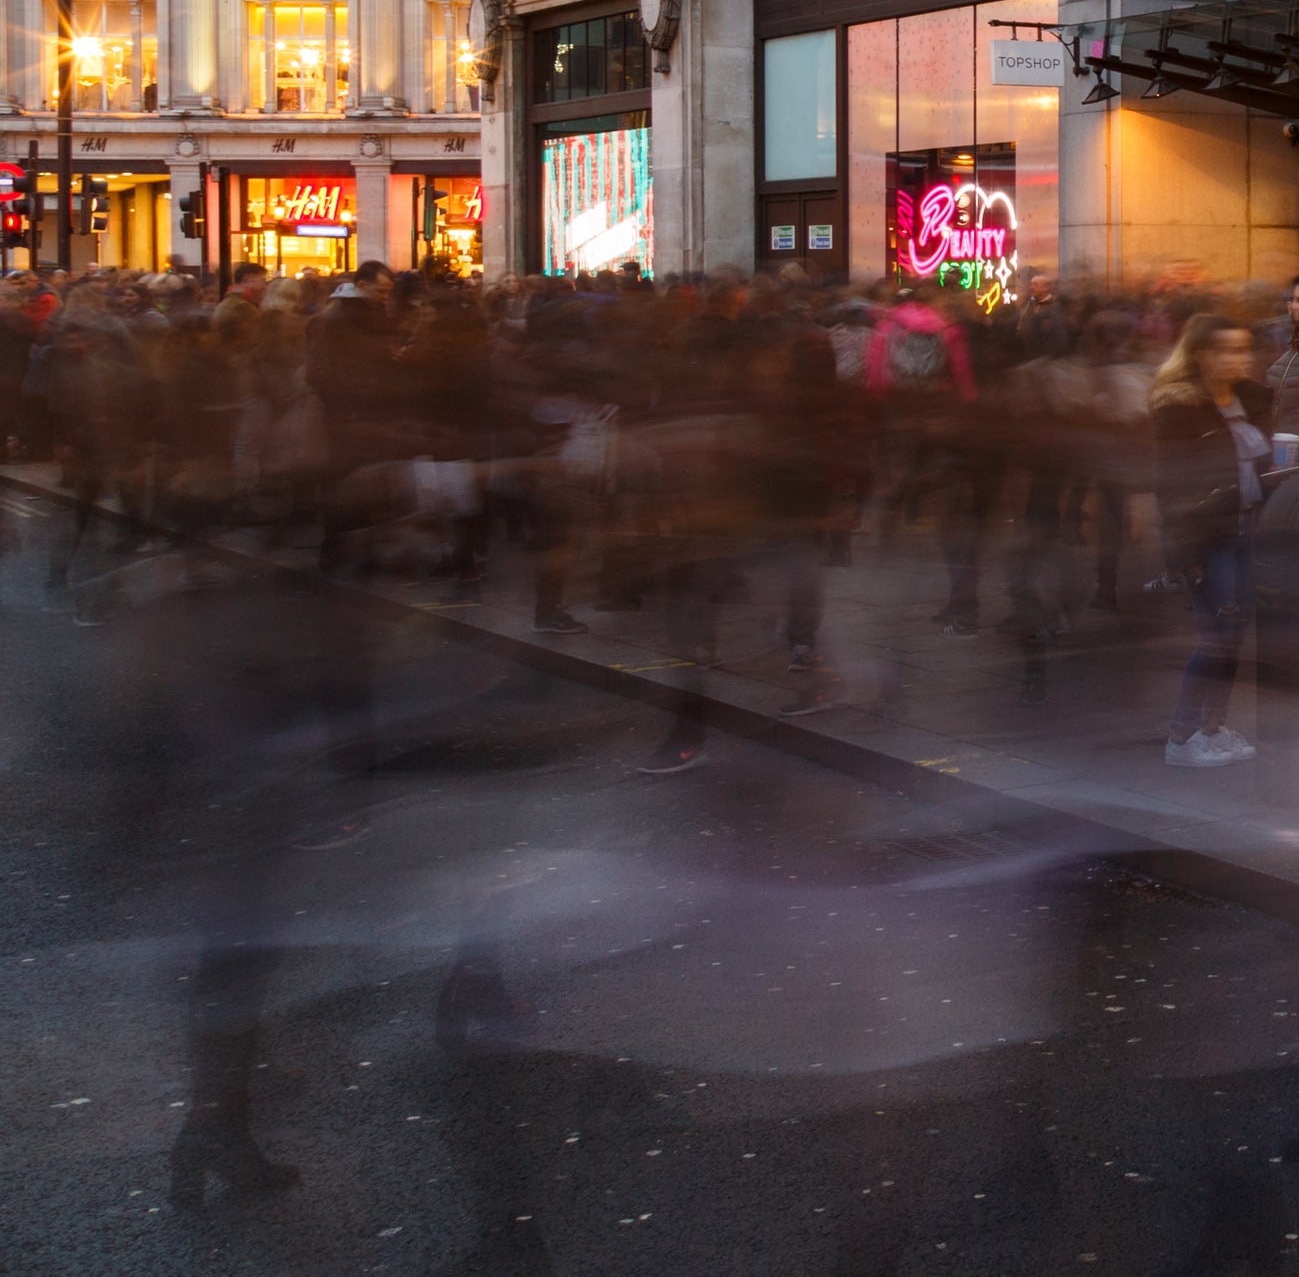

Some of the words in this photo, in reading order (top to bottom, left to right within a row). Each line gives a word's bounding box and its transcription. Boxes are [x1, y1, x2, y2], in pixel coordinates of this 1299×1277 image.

[998, 56, 1061, 70] TOPSHOP
[81, 137, 108, 152] H&M
[271, 138, 296, 153] H&M
[443, 138, 466, 153] H&M
[287, 185, 342, 221] H&M
